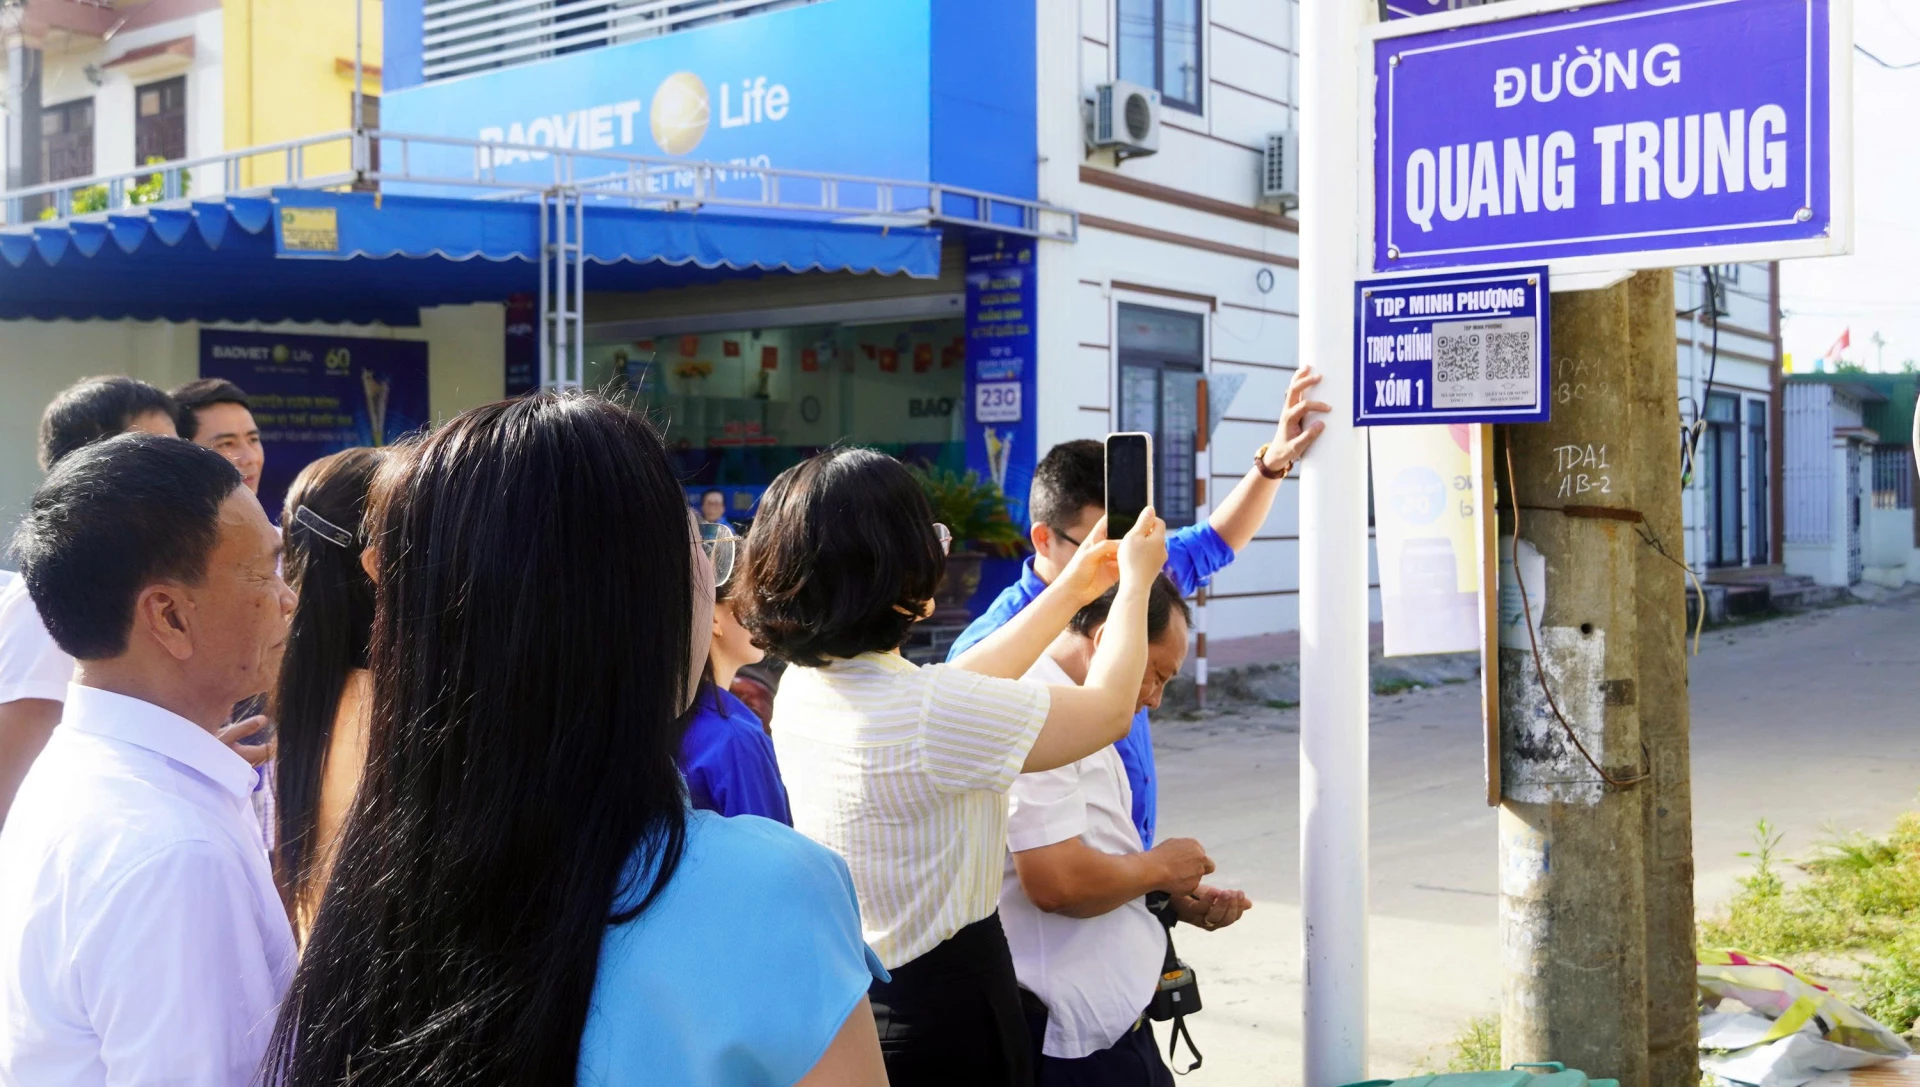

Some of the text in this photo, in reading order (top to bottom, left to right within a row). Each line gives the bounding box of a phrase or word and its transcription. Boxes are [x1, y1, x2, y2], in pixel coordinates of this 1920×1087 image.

[1494, 42, 1681, 108] ĐƯỜNG
[720, 76, 790, 128] Life
[1406, 104, 1787, 233] QUANG TRUNG
[1374, 287, 1525, 317] TDP MINH PHƯỢNG
[212, 344, 269, 360] BAOVIET
[1367, 327, 1432, 367] TRỤC CHÍNH
[981, 388, 1016, 408] 230
[1375, 373, 1424, 407] XÓM 1
[908, 397, 955, 418] BAO
[1553, 444, 1610, 472] TDA1
[1557, 474, 1611, 498] AB-2
